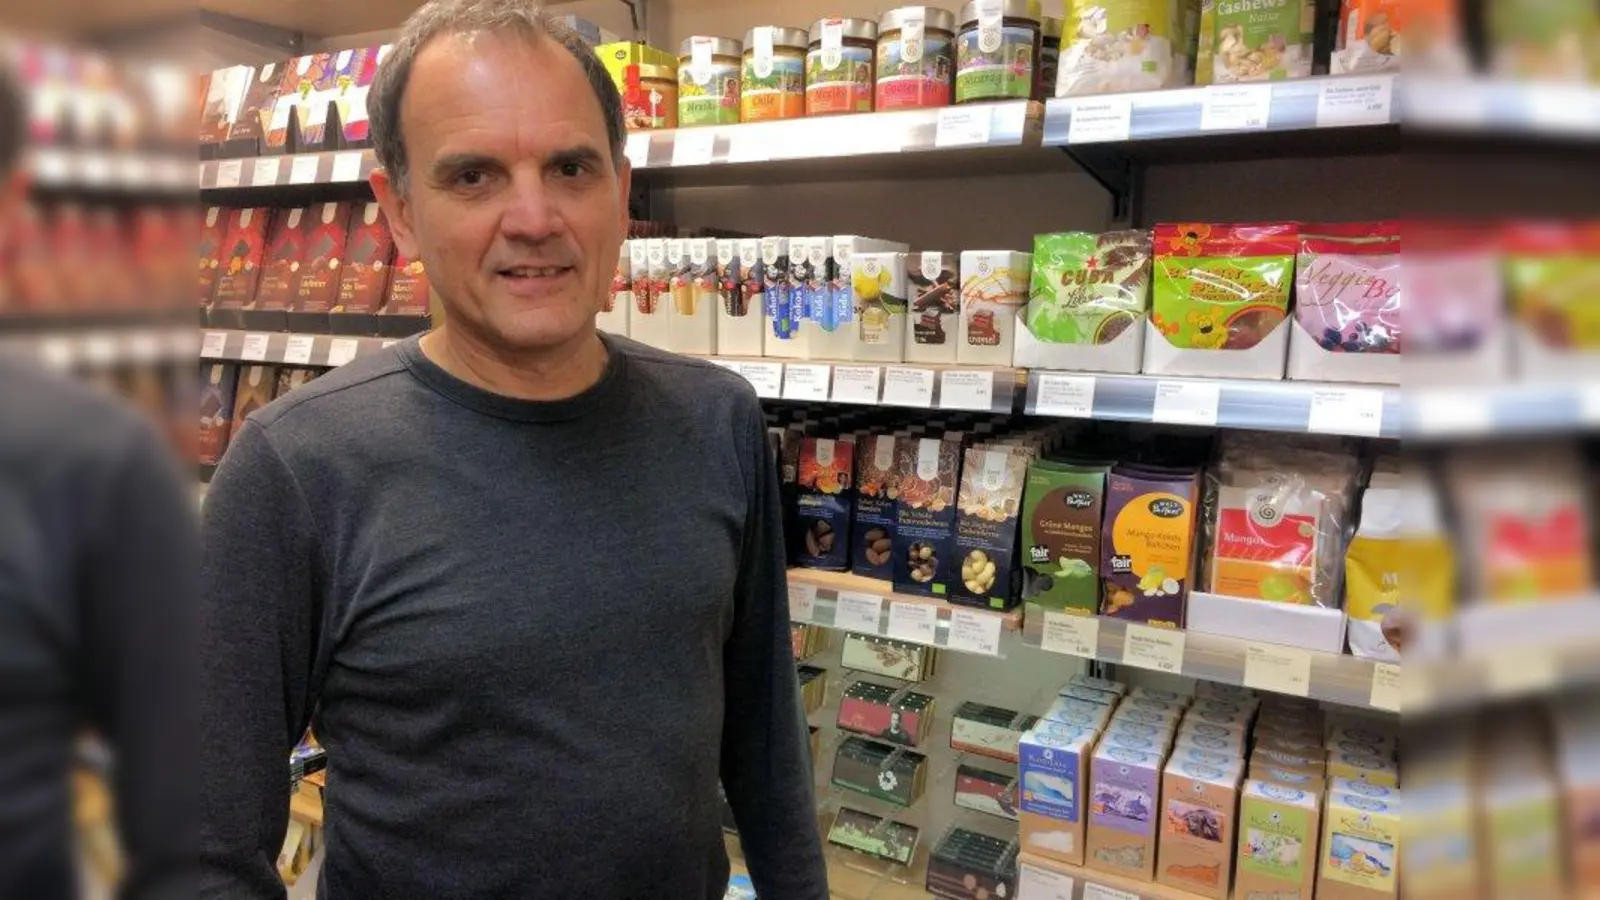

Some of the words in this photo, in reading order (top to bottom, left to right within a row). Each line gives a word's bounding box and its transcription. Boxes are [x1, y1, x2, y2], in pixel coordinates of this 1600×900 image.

[793, 290, 803, 322] Kokos
[838, 293, 848, 317] Kids
[1030, 545, 1050, 558] fair
[1112, 556, 1132, 569] fair
